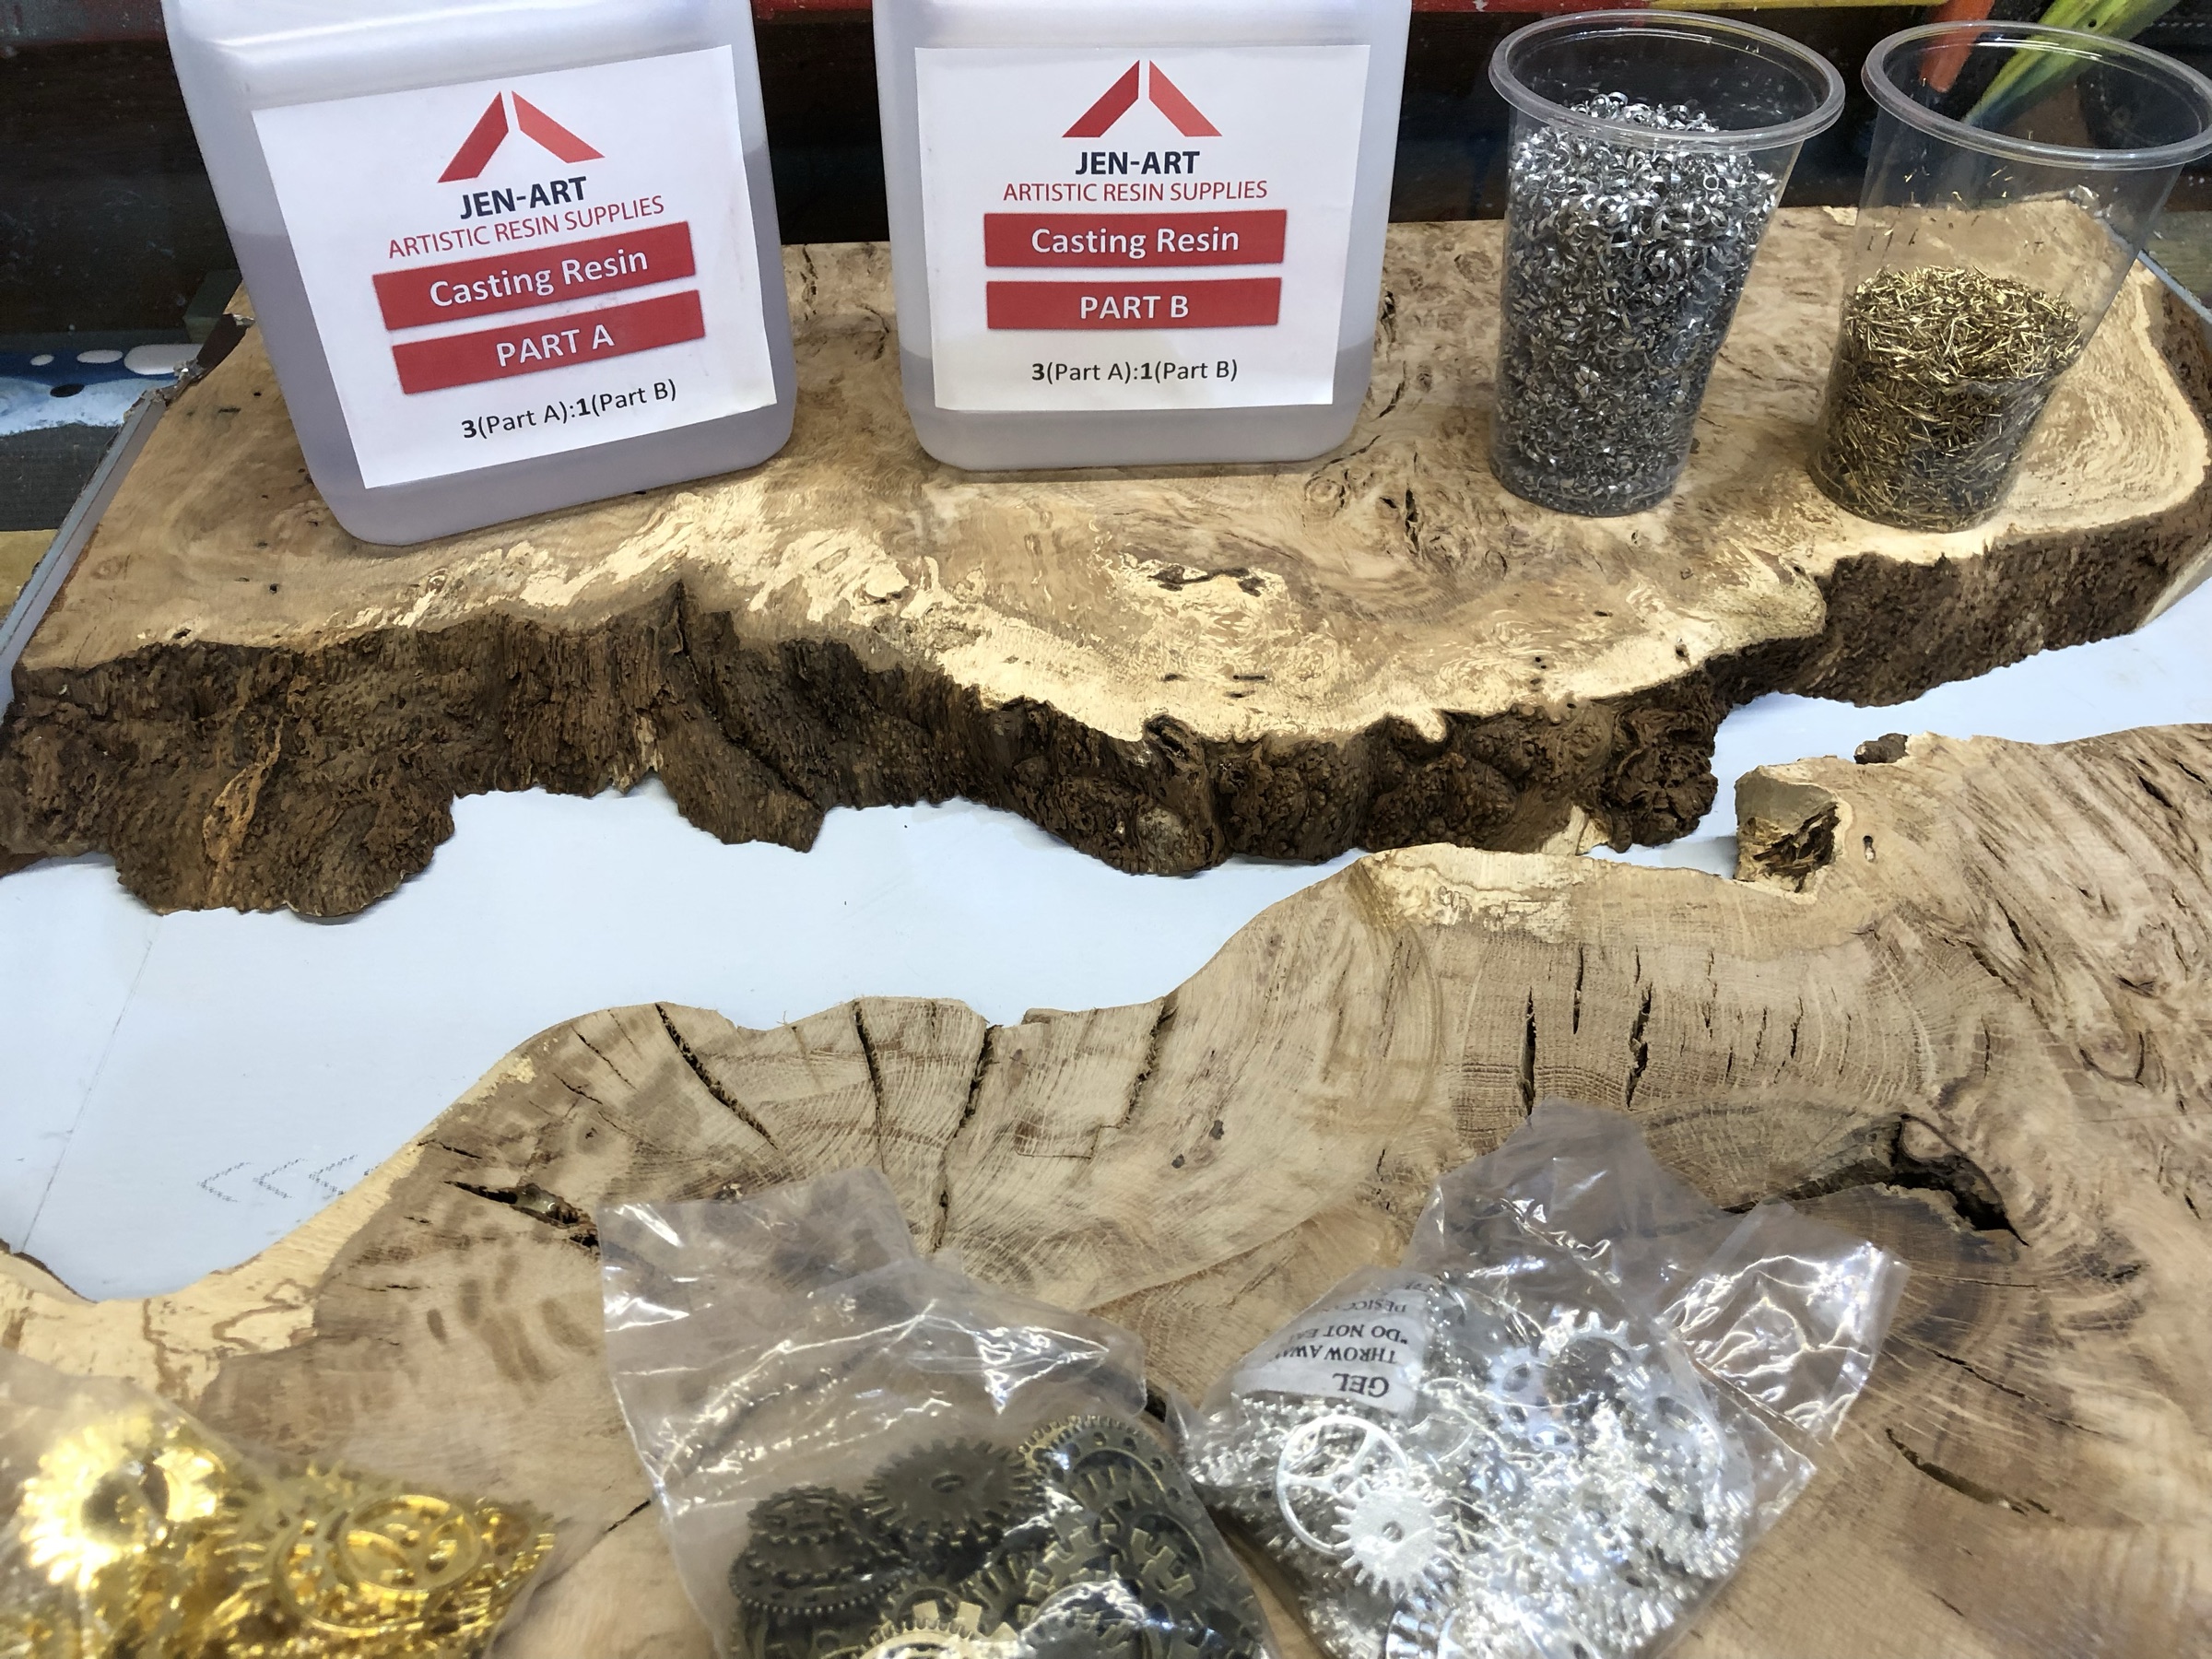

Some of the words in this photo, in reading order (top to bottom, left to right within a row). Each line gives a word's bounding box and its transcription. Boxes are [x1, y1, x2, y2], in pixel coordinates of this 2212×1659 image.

[1075, 150, 1201, 176] JEN-ART
[459, 176, 588, 220] JEN-ART
[1003, 183, 1098, 203] ARTISTIC
[1103, 182, 1165, 202] RESIN
[1171, 180, 1268, 202] SUPPLIES
[388, 226, 490, 258] ARTISTIC
[495, 215, 560, 243] RESIN
[565, 195, 665, 230] SUPPLIES
[1030, 228, 1147, 260] Casting
[1157, 227, 1240, 253] Resin
[429, 266, 553, 309] Casting
[561, 248, 649, 285] Resin
[1079, 295, 1162, 320] PART
[1171, 295, 1189, 319] B
[496, 328, 581, 368] PART
[591, 324, 616, 349] A
[1030, 361, 1101, 385] 3(Part
[1107, 359, 1209, 384] A):1(Part
[1216, 358, 1238, 382] B)
[461, 408, 536, 440] 3(Part
[543, 387, 647, 425] A):1(Part
[653, 378, 677, 404] B)
[1322, 1299, 1407, 1312] DESICC
[1323, 1324, 1365, 1338] NOT
[1324, 1346, 1398, 1364] THROW
[1332, 1372, 1390, 1398] GEL
